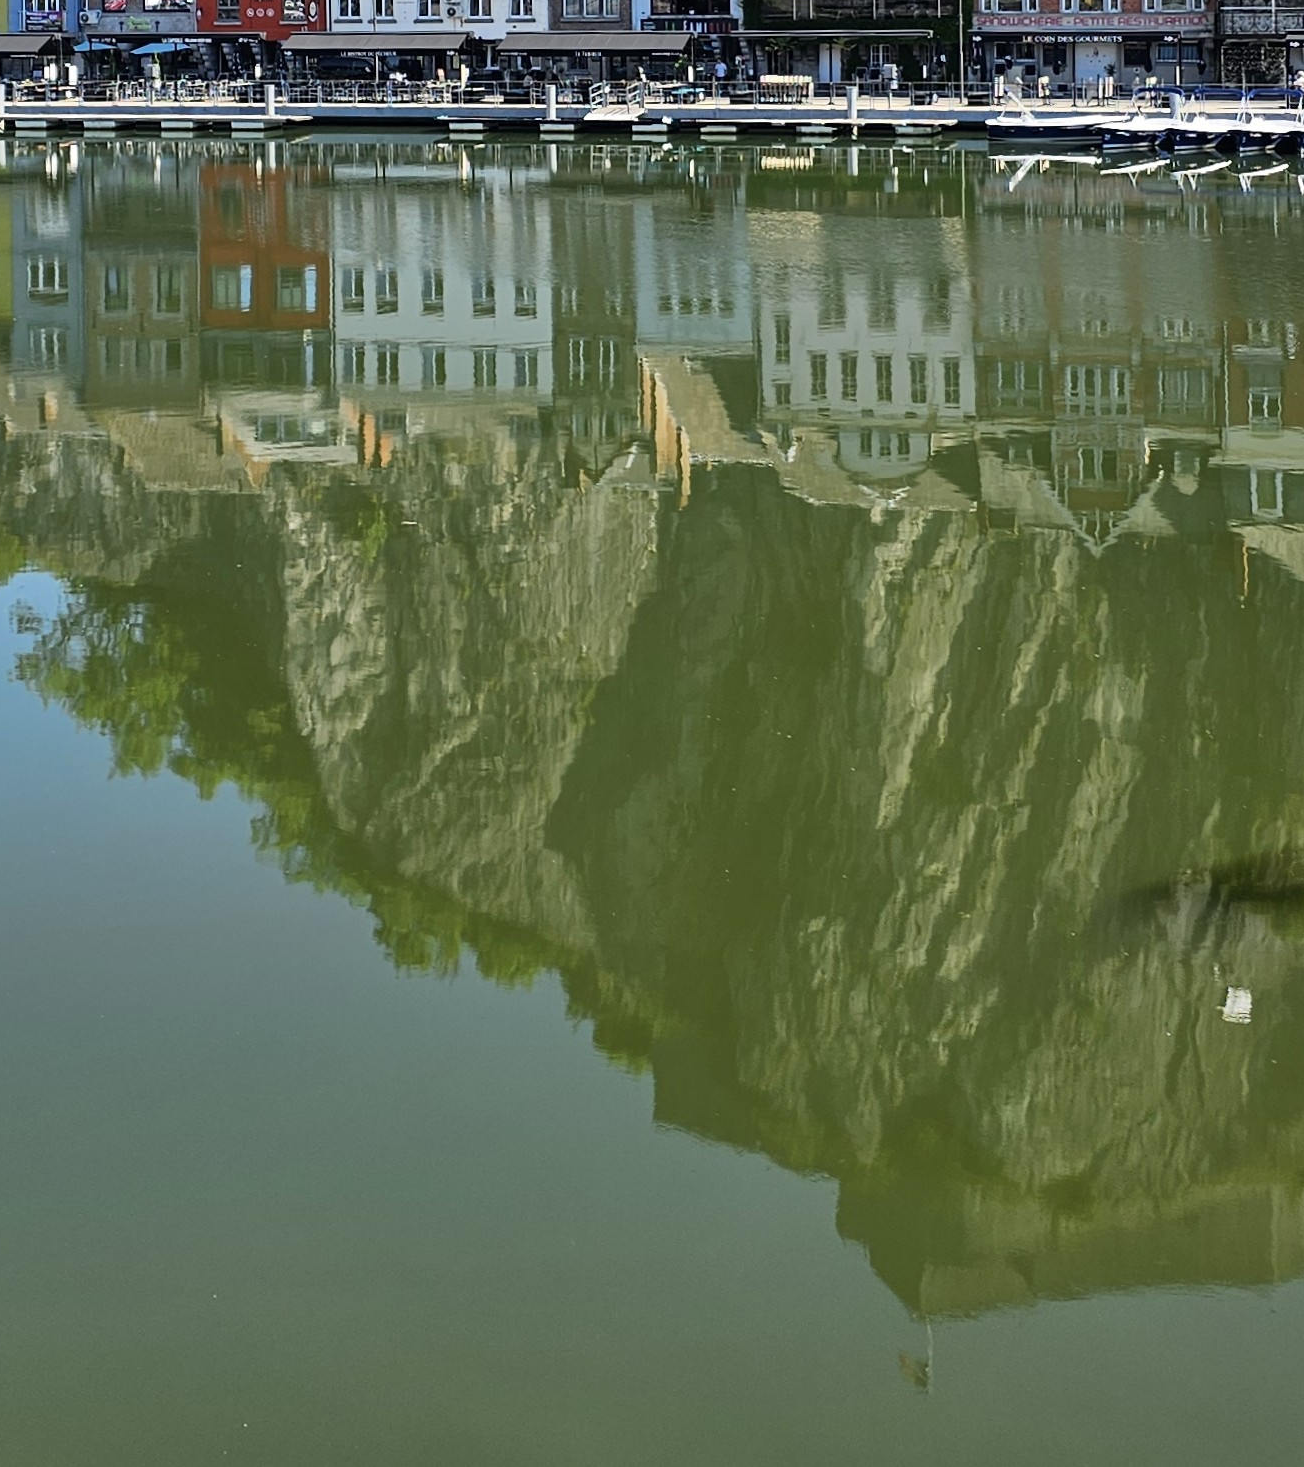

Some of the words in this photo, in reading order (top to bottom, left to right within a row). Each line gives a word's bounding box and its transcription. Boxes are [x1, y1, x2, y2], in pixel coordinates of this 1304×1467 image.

[977, 16, 1063, 26] SANDWICHERIE
[1074, 16, 1114, 26] PETITE
[1118, 15, 1210, 26] RESTAURATION
